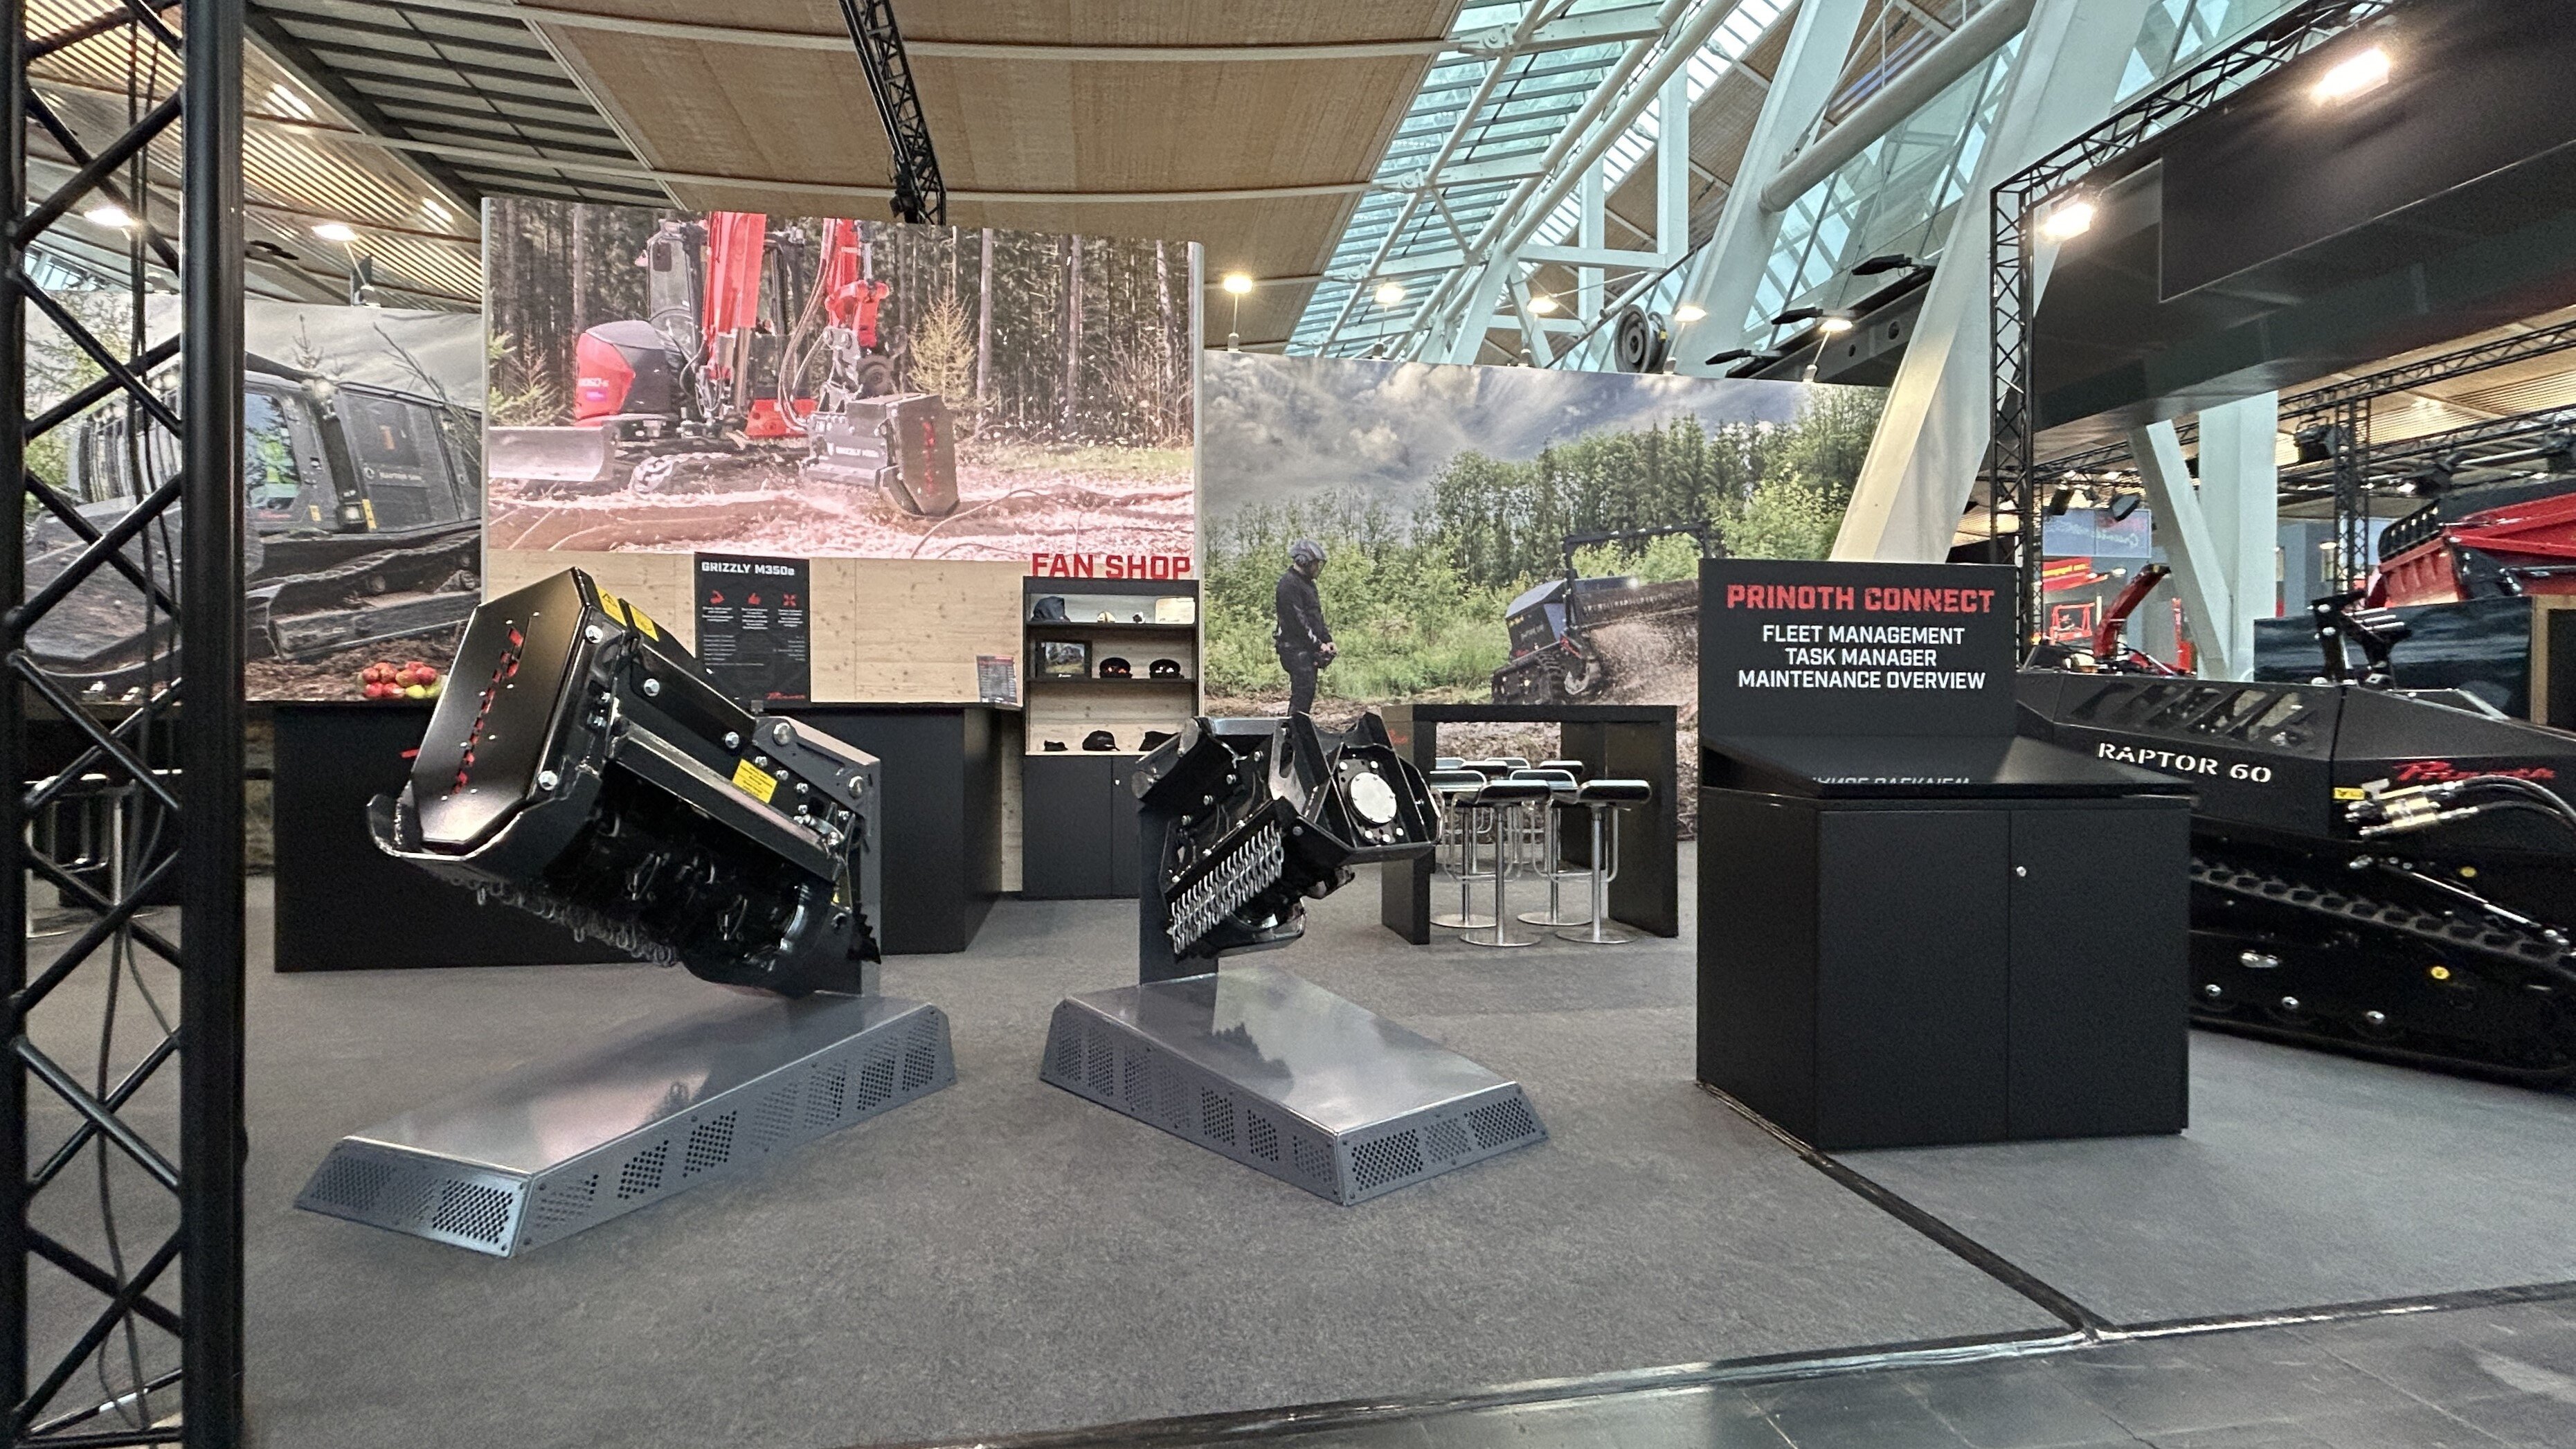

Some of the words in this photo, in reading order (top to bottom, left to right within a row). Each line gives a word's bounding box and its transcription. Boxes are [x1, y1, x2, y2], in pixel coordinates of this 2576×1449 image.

[701, 561, 751, 573] GRIZZLY
[1032, 553, 1094, 577] FAN
[1106, 555, 1191, 579] SHOP
[1727, 584, 1855, 610] PRINOTH
[1864, 588, 1994, 613] CONNECT
[1763, 625, 1823, 643] FLEET
[1828, 626, 1965, 645] MANAGEMENT
[1785, 648, 1836, 665] TASK
[1841, 649, 1937, 667] MANAGER
[1738, 670, 1882, 689] MAINTENANCE
[1886, 672, 1986, 690] OVERVIEW
[2098, 743, 2218, 775] RAPTOR
[2229, 764, 2271, 783] 60
